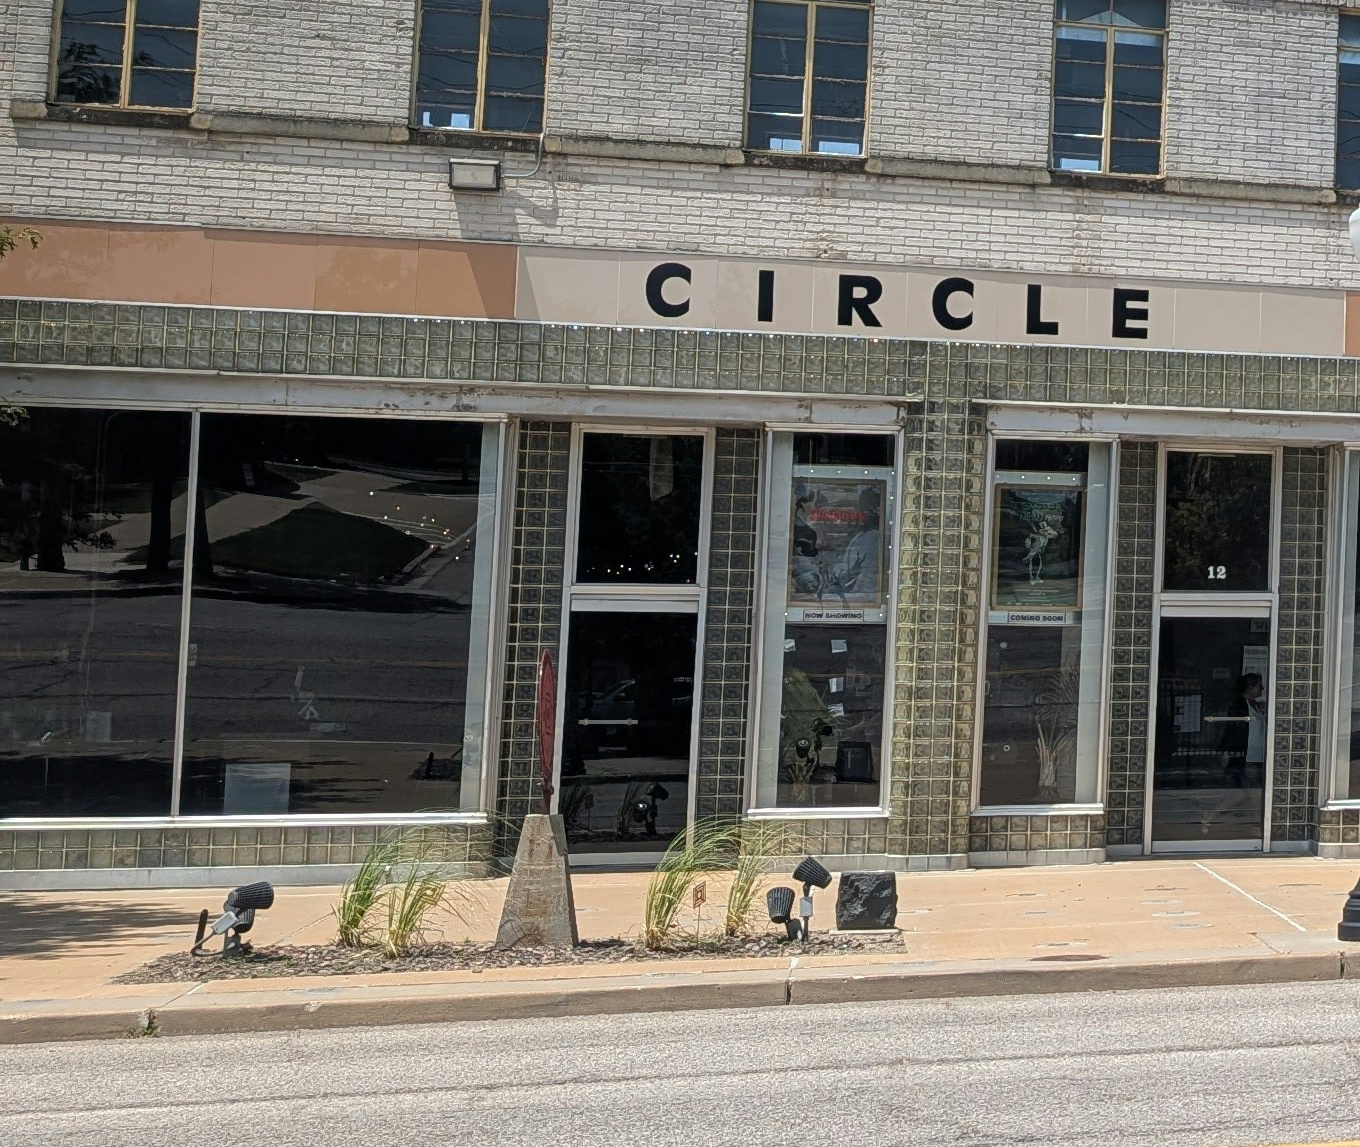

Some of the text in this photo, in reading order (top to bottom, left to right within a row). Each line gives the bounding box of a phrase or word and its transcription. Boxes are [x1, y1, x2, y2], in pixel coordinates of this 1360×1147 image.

[645, 262, 1150, 339] CIRCLE
[1207, 565, 1227, 580] 12
[825, 612, 863, 620] SHOWING
[1010, 614, 1041, 622] COMING
